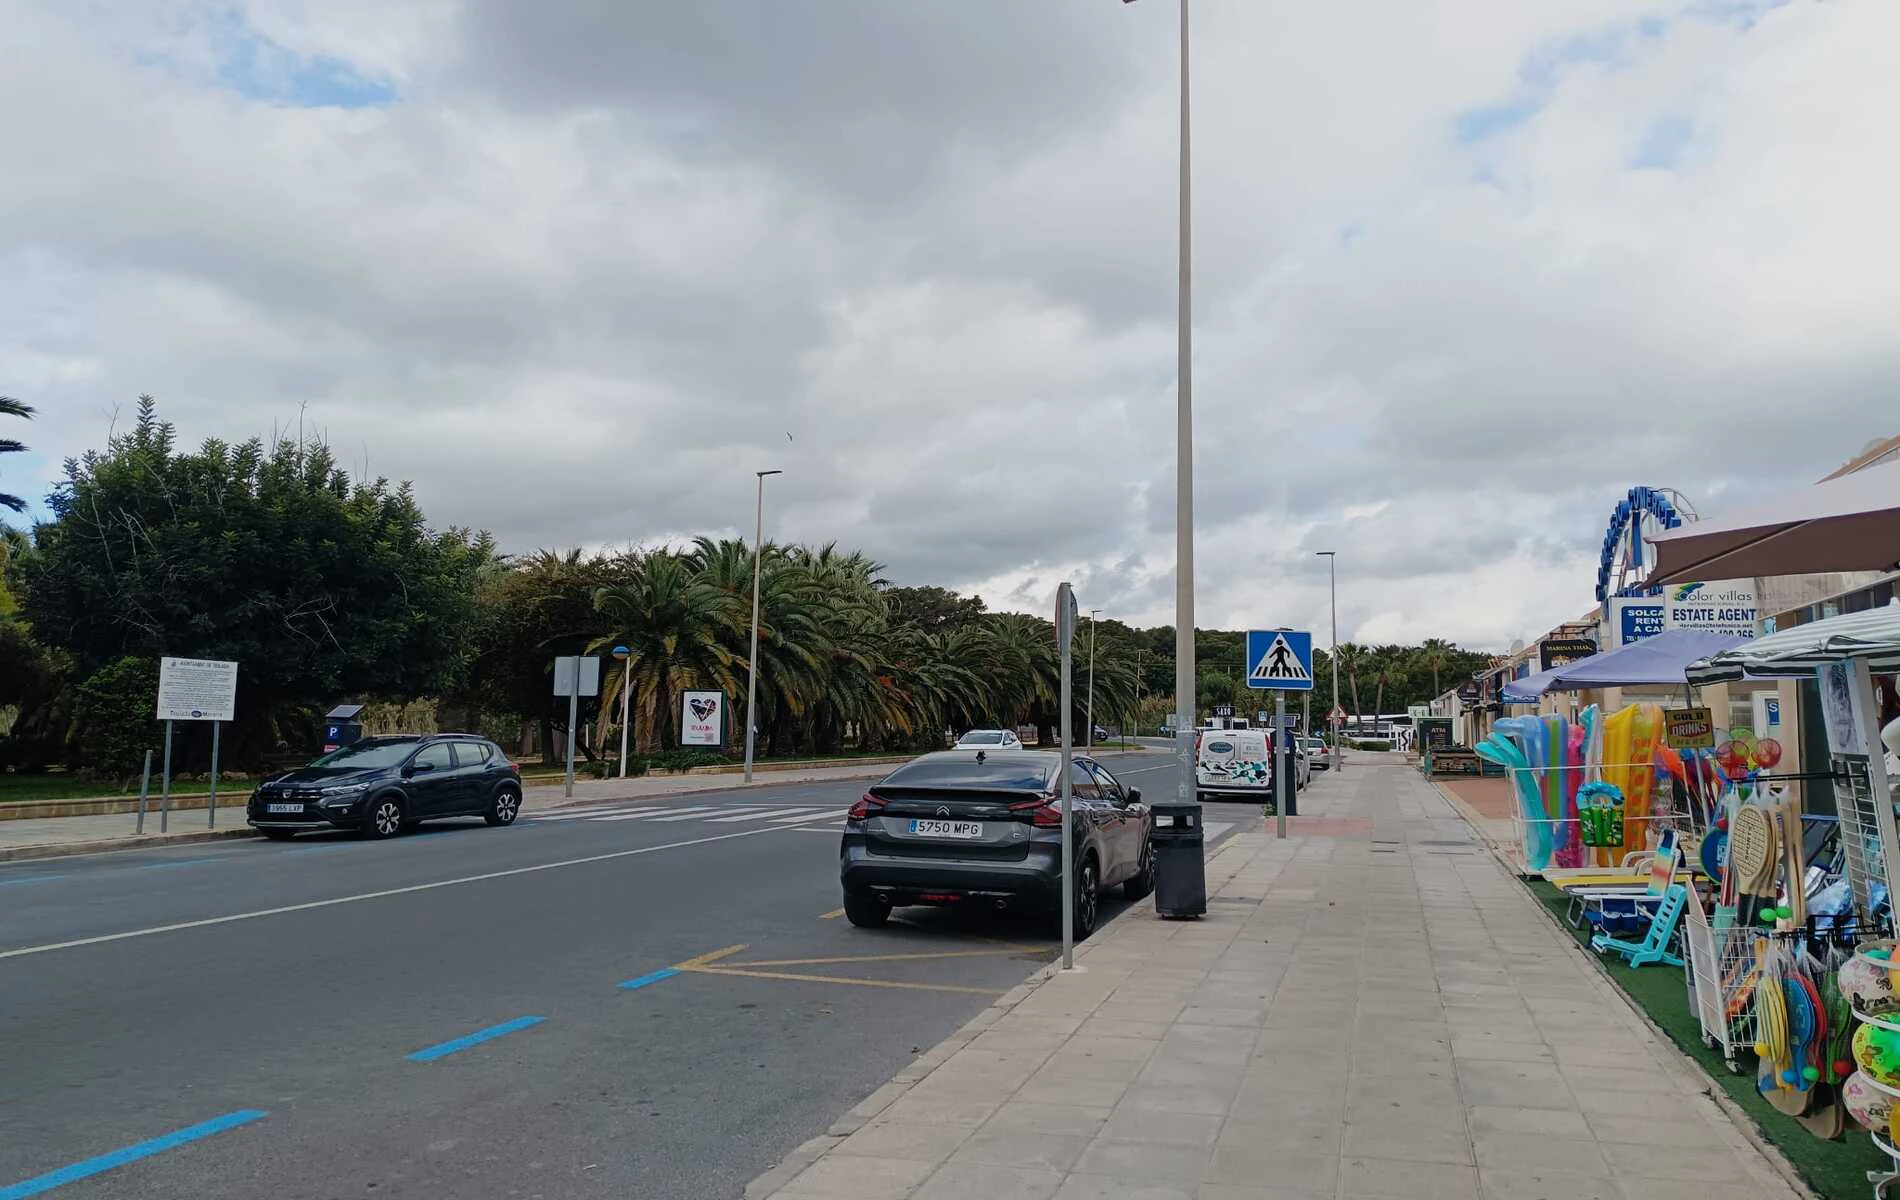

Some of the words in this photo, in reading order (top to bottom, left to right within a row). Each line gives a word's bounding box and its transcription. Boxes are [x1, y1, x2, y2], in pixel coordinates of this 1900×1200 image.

[1719, 590, 1752, 601] villas
[1672, 609, 1714, 621] ESTATE
[1718, 609, 1756, 621] AGENT
[329, 727, 338, 737] P
[919, 821, 950, 833] 5750
[953, 823, 978, 835] MPG
